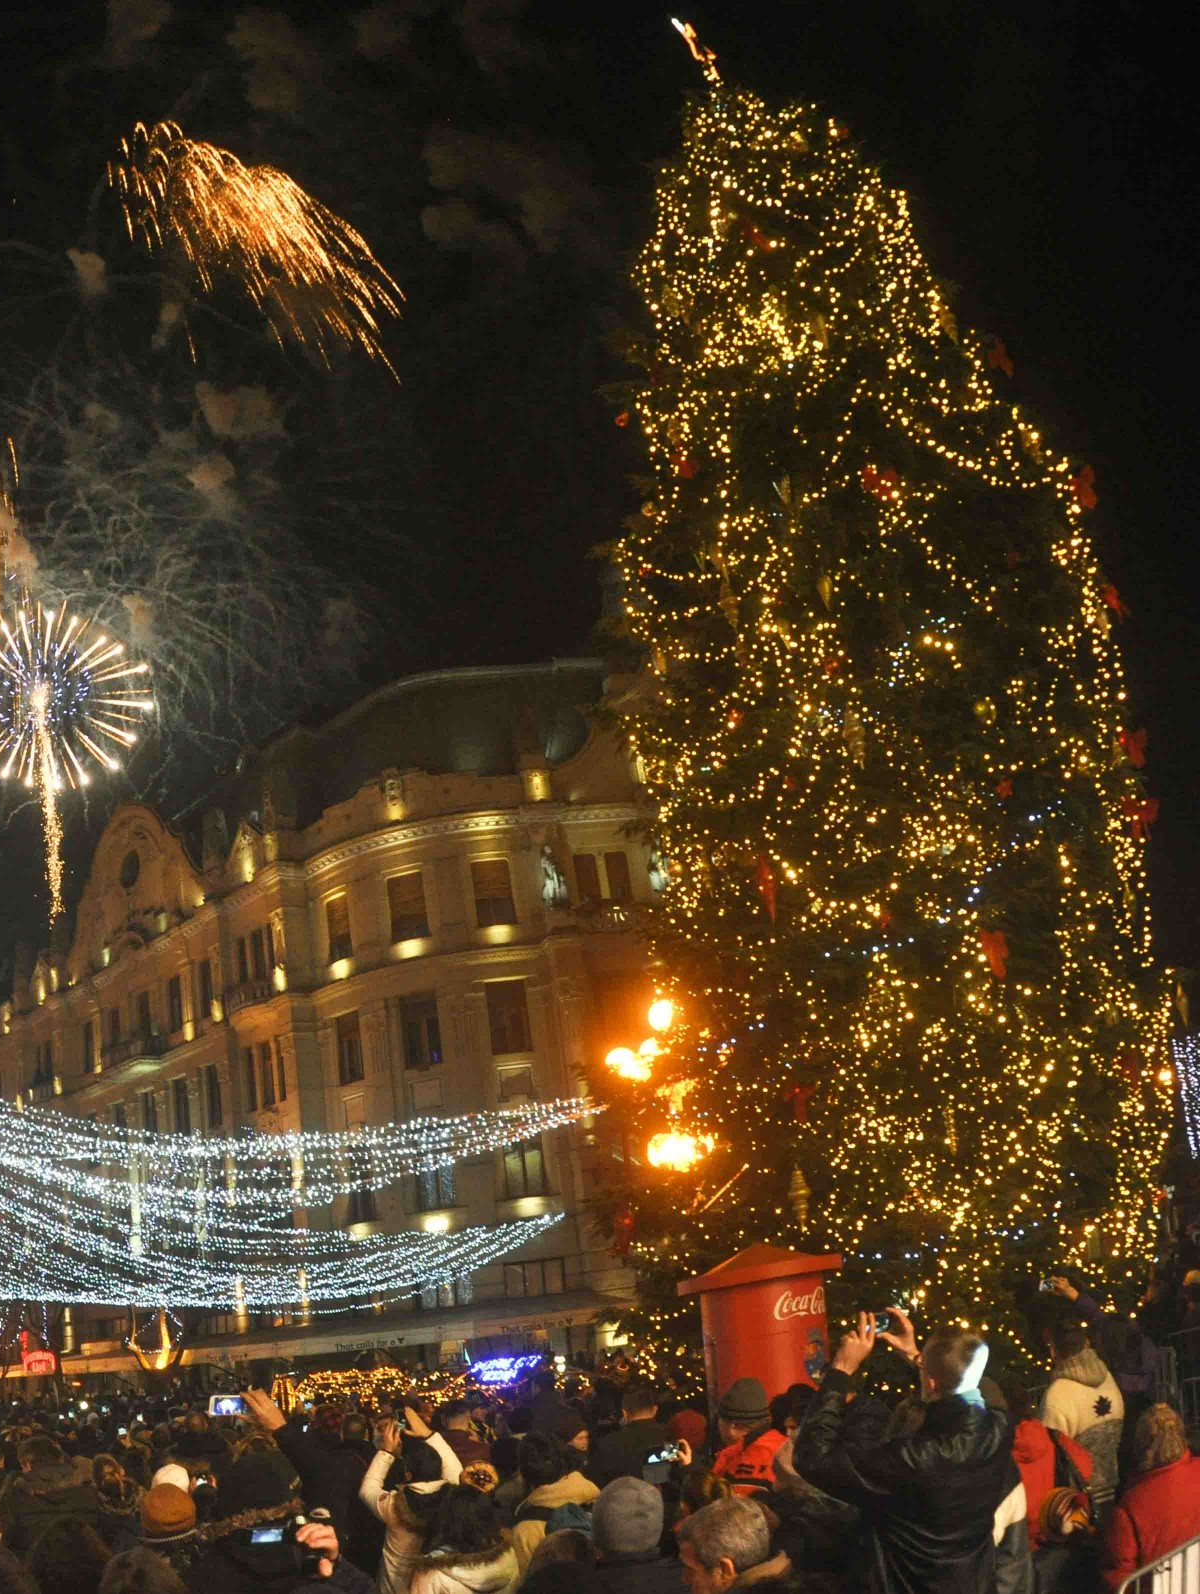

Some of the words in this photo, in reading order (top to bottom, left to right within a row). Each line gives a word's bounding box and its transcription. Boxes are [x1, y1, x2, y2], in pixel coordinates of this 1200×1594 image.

[336, 1343, 354, 1352] That
[356, 1340, 374, 1350] calls
[376, 1337, 388, 1347] for
